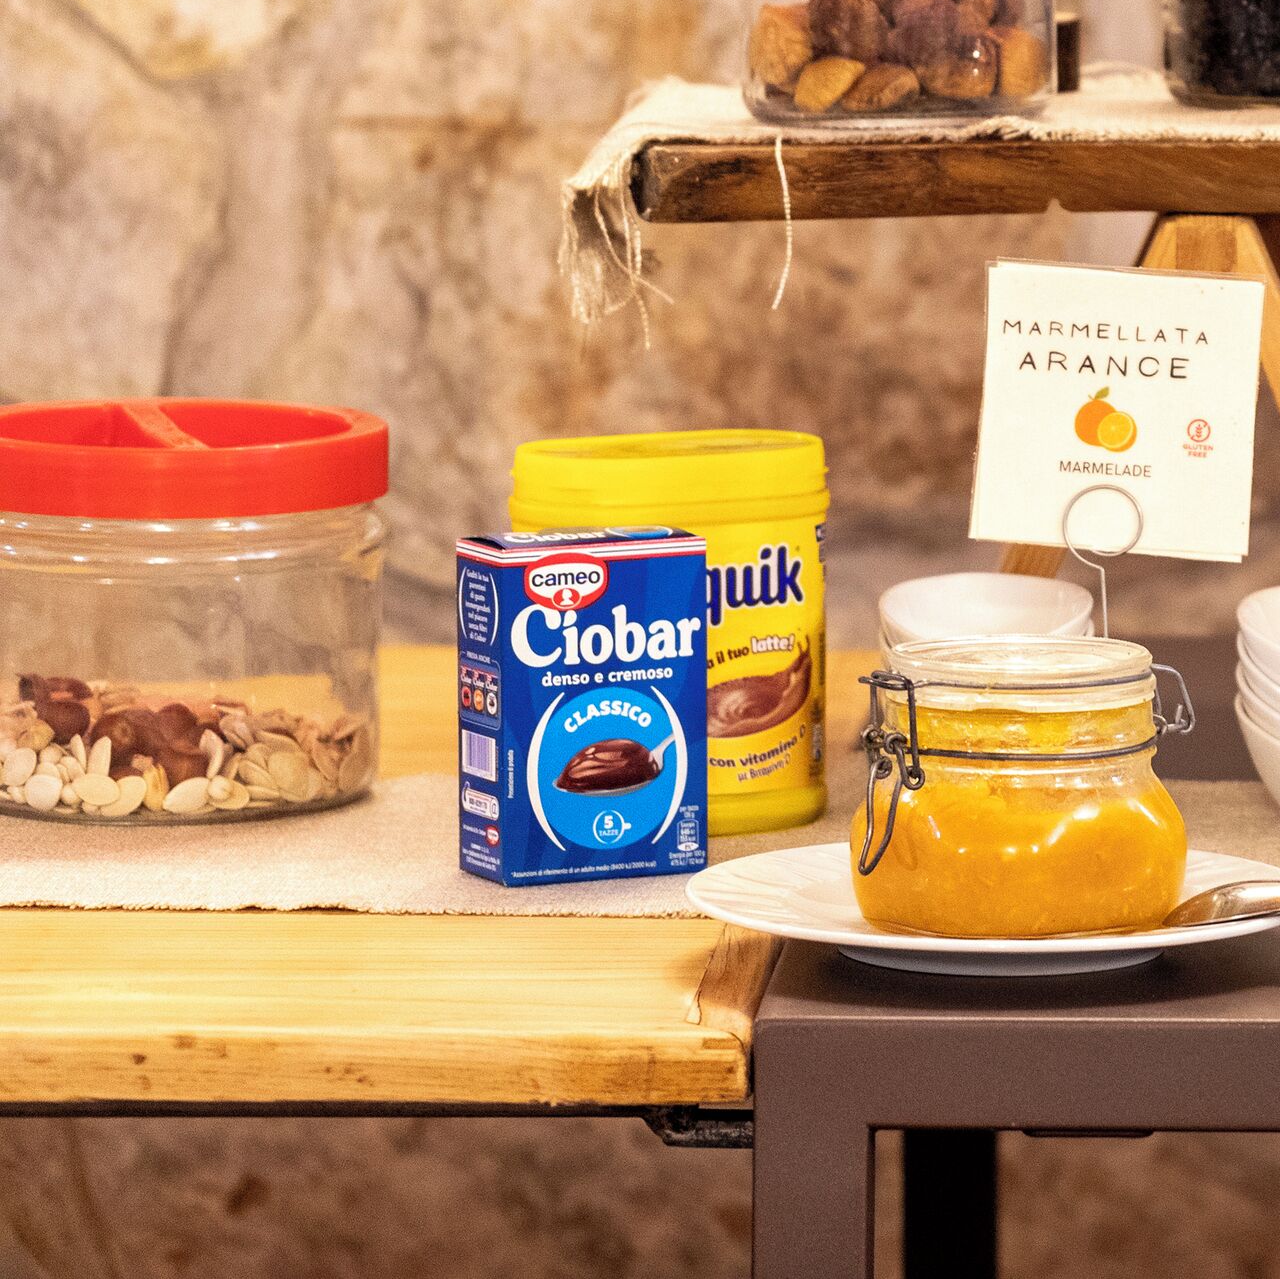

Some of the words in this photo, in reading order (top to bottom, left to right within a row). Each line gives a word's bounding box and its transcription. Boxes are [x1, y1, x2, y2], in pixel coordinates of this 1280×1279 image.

[1003, 319, 1209, 345] MARMELLATA
[1019, 351, 1190, 379] ARANCE
[1182, 443, 1214, 452] GLUTEN
[1059, 460, 1152, 478] MARMELADE
[504, 531, 606, 544] Ciobar
[531, 570, 600, 587] cameo
[705, 545, 804, 626] quik
[510, 604, 701, 668] Ciobar
[716, 650, 725, 664] il
[727, 646, 749, 660] tuo
[750, 633, 795, 653] latte!
[541, 671, 590, 687] denso
[594, 672, 604, 683] e
[608, 667, 673, 682] cremoso
[563, 700, 652, 733] CLASSICO
[709, 757, 736, 769] con
[604, 815, 614, 829] 5
[599, 829, 619, 837] TAZZE
